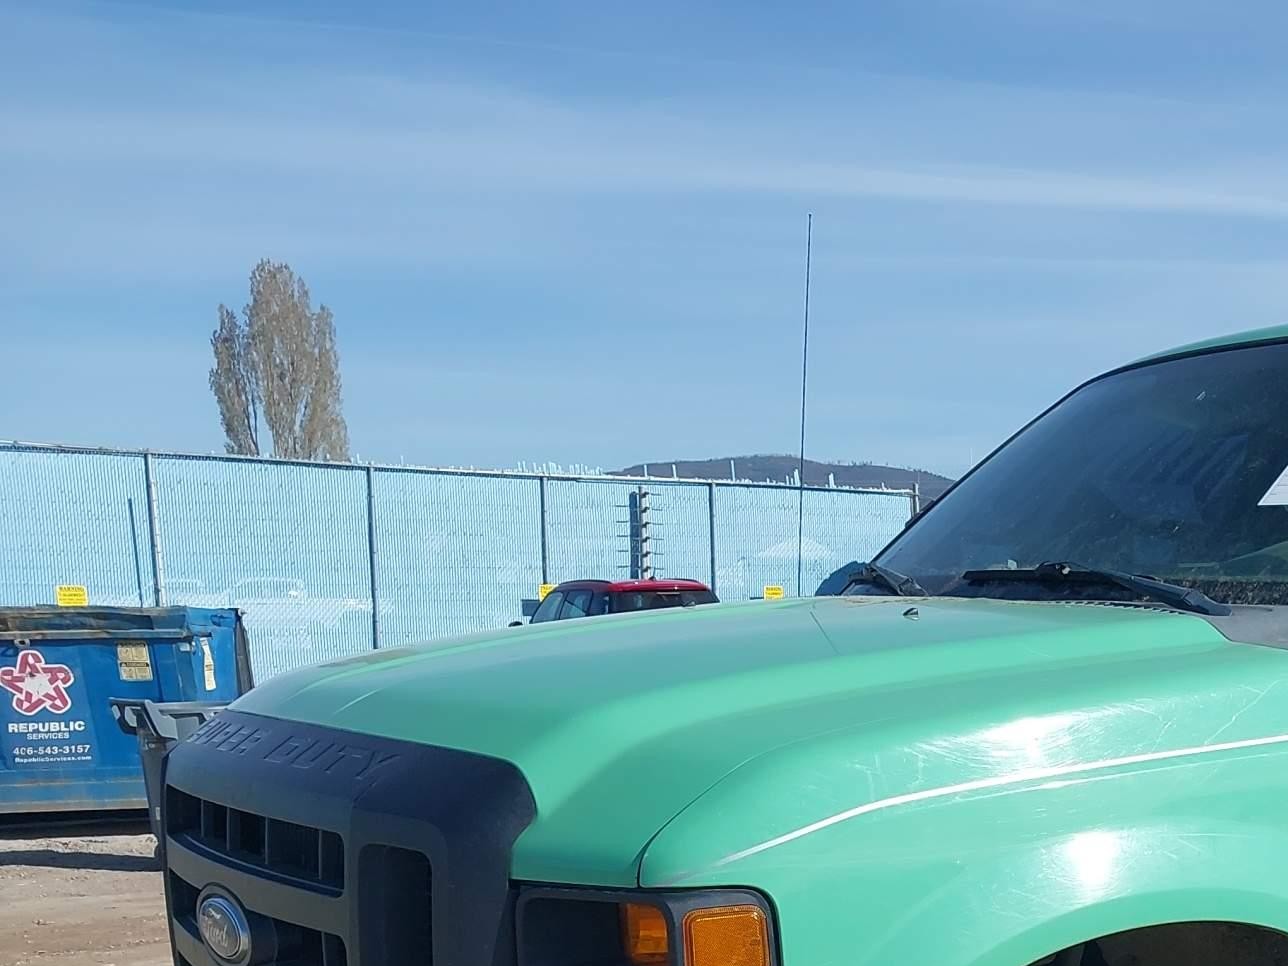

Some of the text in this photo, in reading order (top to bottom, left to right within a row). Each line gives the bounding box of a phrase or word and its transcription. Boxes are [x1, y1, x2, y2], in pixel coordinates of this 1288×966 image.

[8, 721, 86, 733] REPUBLIC
[26, 732, 70, 740] SERVICES
[13, 745, 91, 755] 406-543-3157
[264, 734, 402, 780] DUTY
